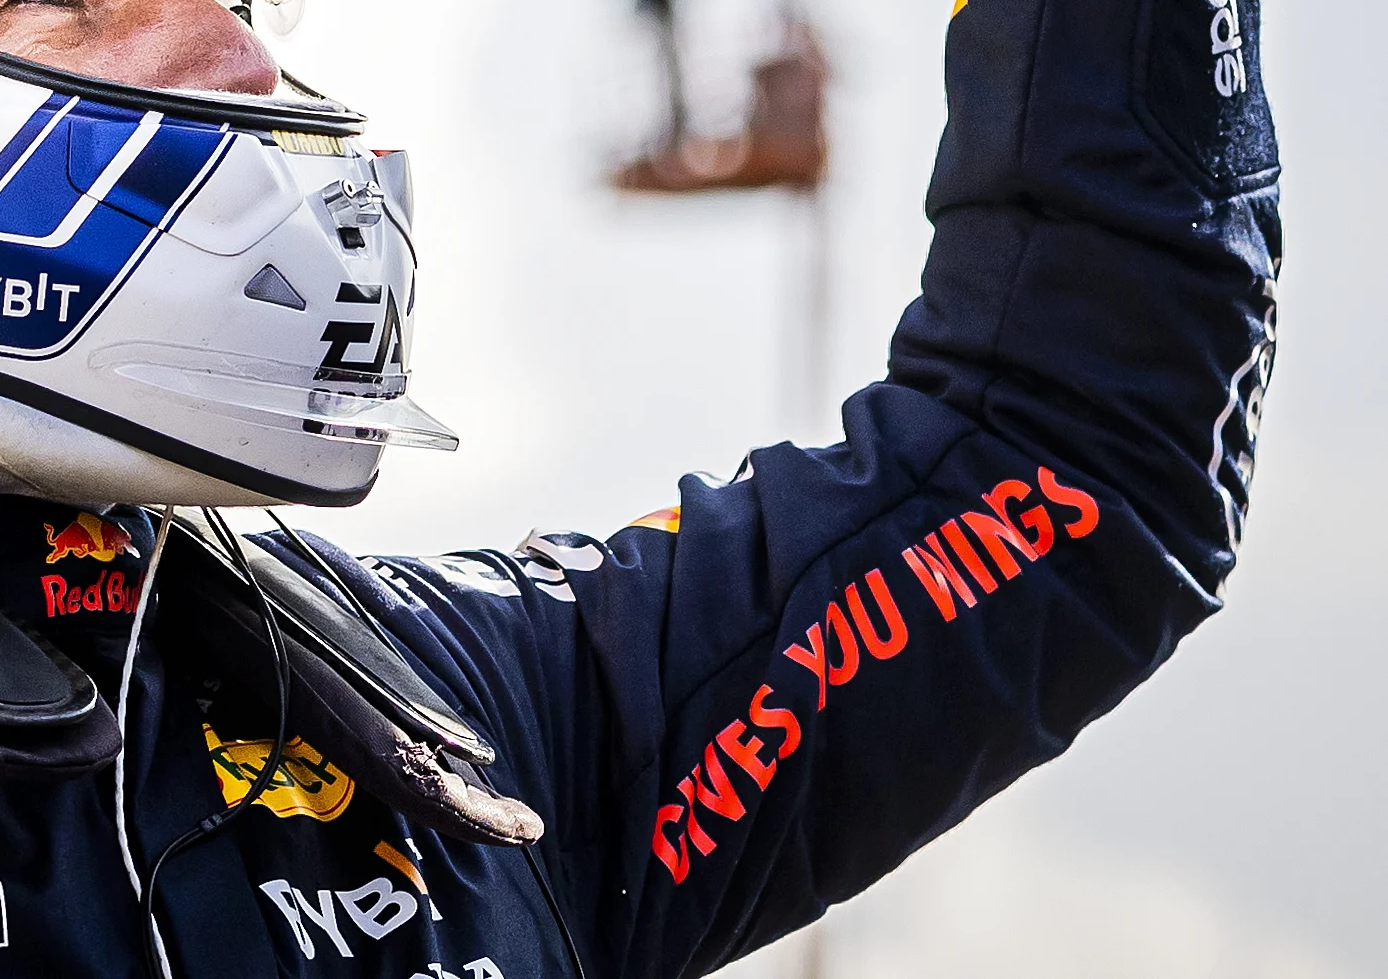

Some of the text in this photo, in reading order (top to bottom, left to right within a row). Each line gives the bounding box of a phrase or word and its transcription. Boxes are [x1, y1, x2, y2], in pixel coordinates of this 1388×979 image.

[40, 569, 104, 617] Red
[652, 466, 1100, 886] GIVES YOU WINGS
